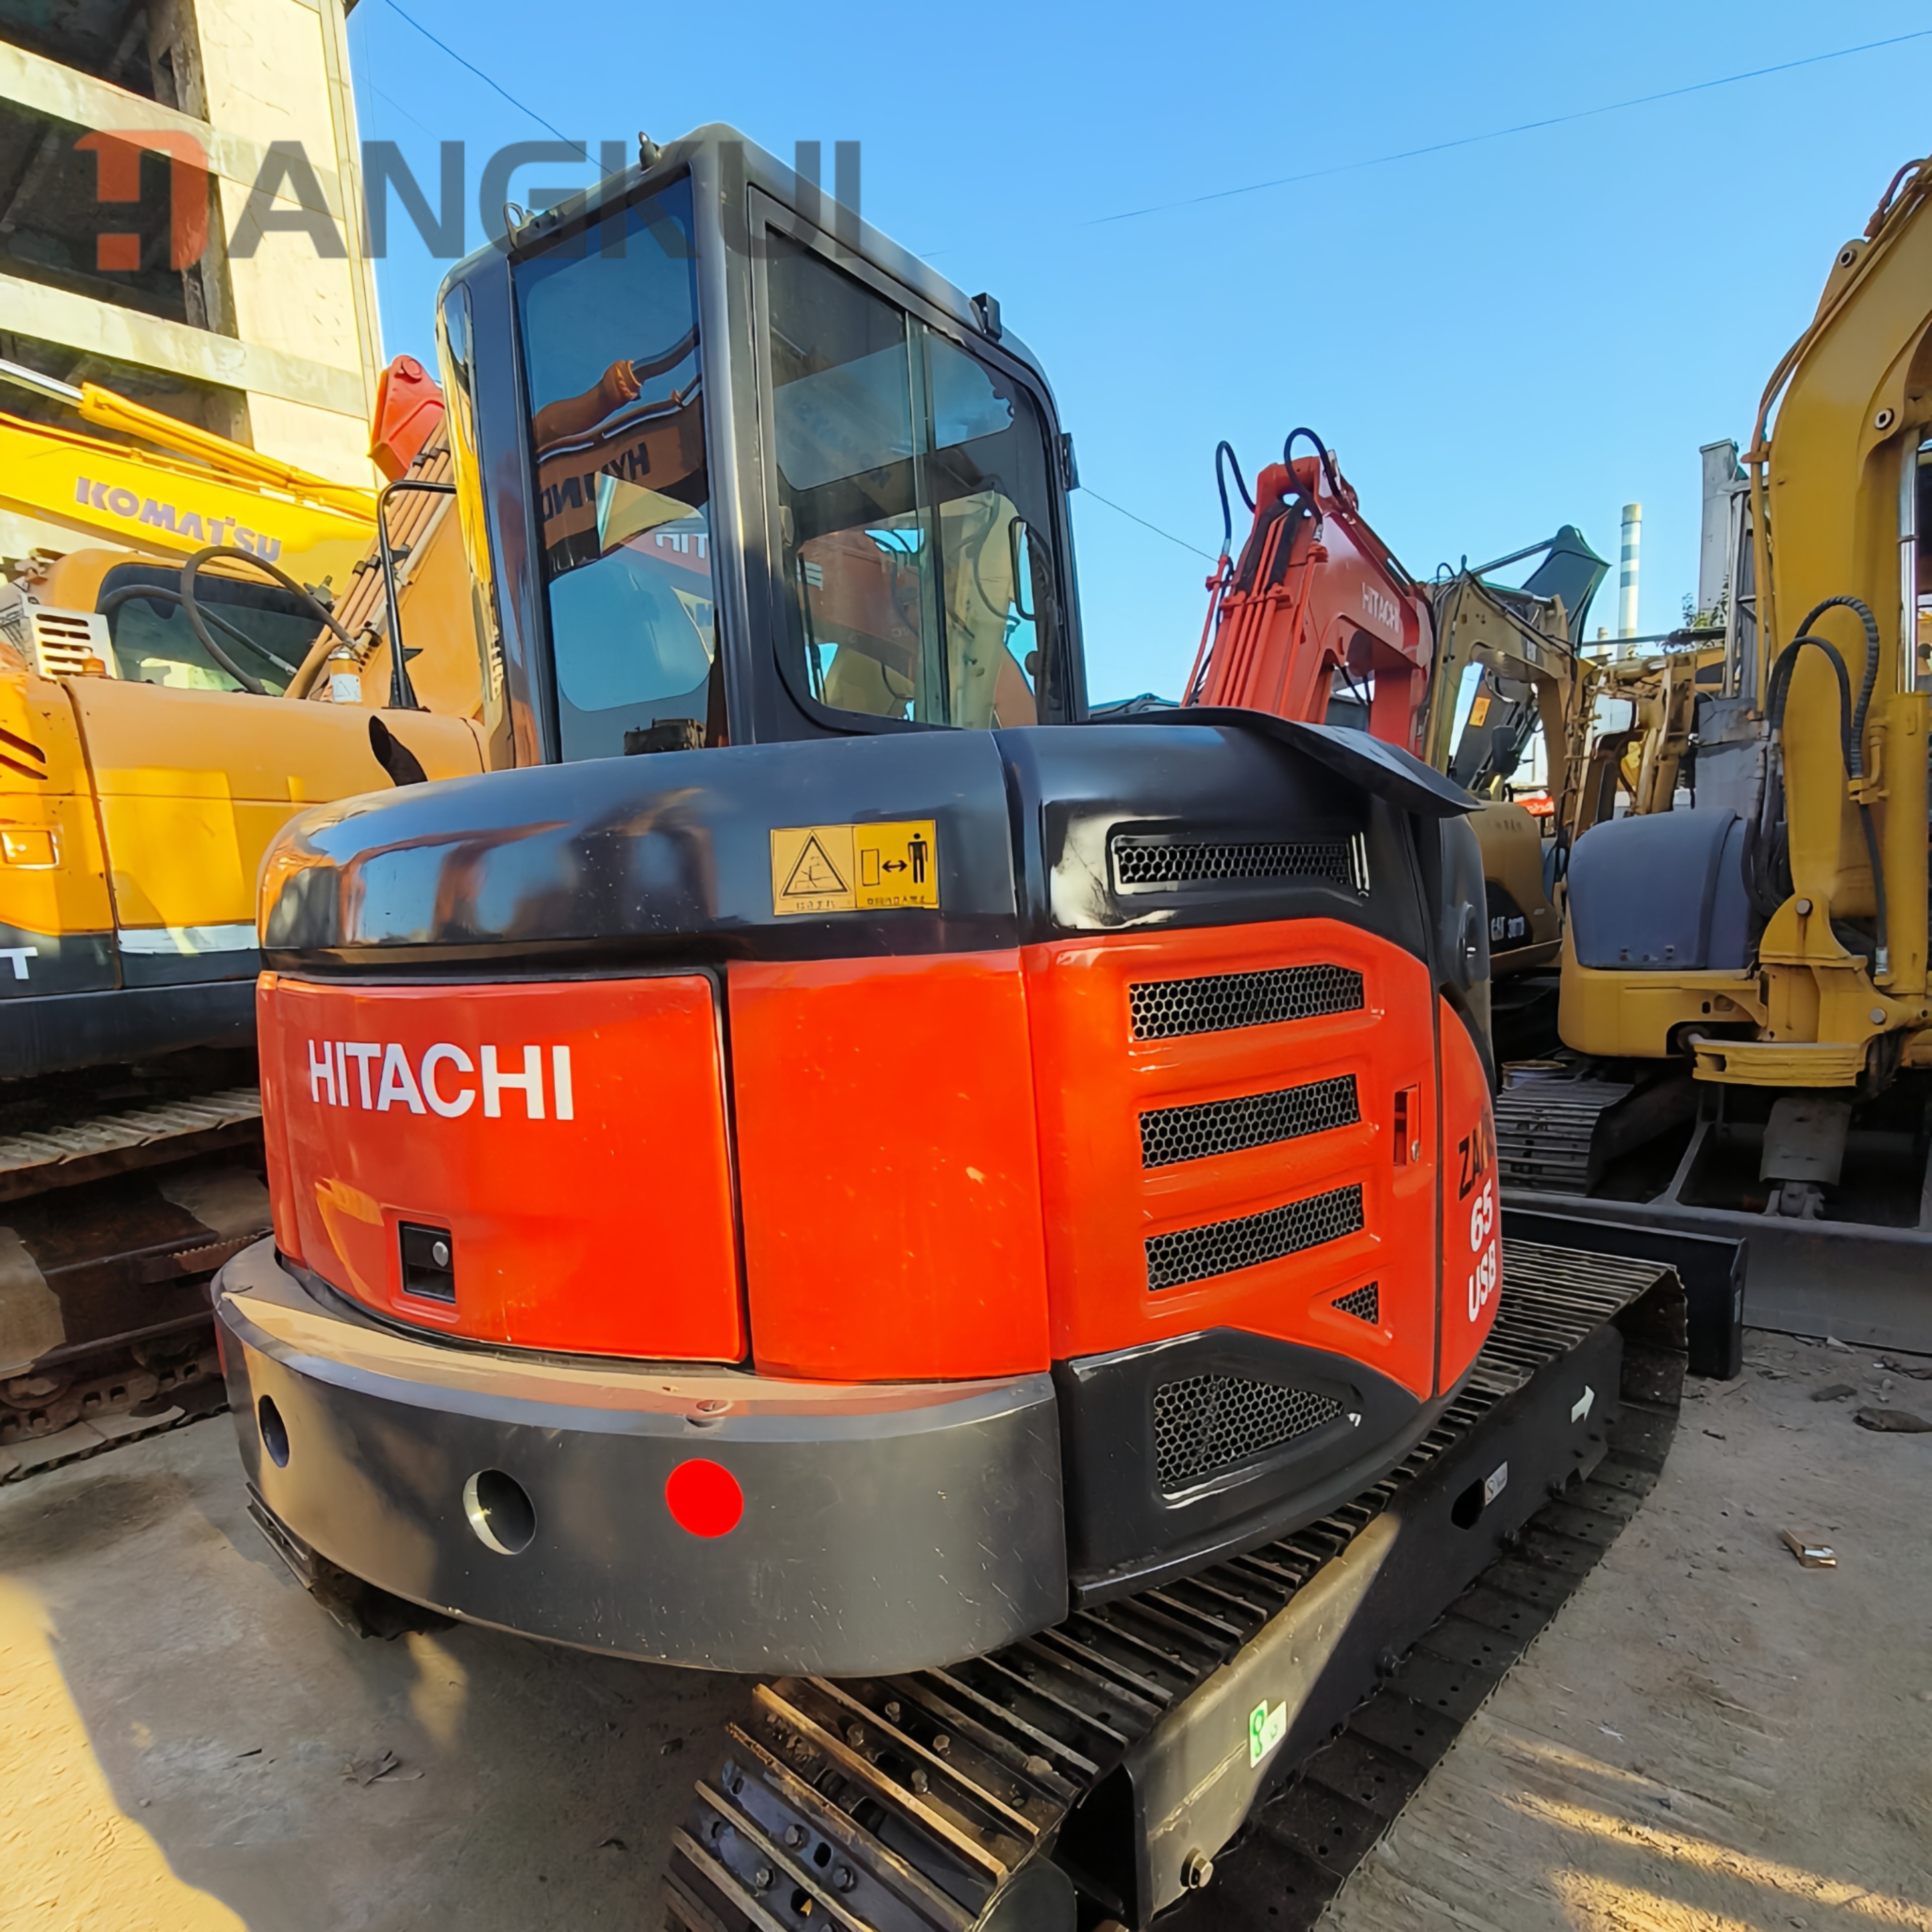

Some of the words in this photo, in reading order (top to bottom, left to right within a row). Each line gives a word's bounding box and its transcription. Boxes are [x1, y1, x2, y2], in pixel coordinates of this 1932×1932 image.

[76, 476, 281, 562] KOMATSU
[308, 1039, 574, 1120] HITACHI
[1470, 1177, 1493, 1252] 65
[1468, 1239, 1496, 1322] USB
